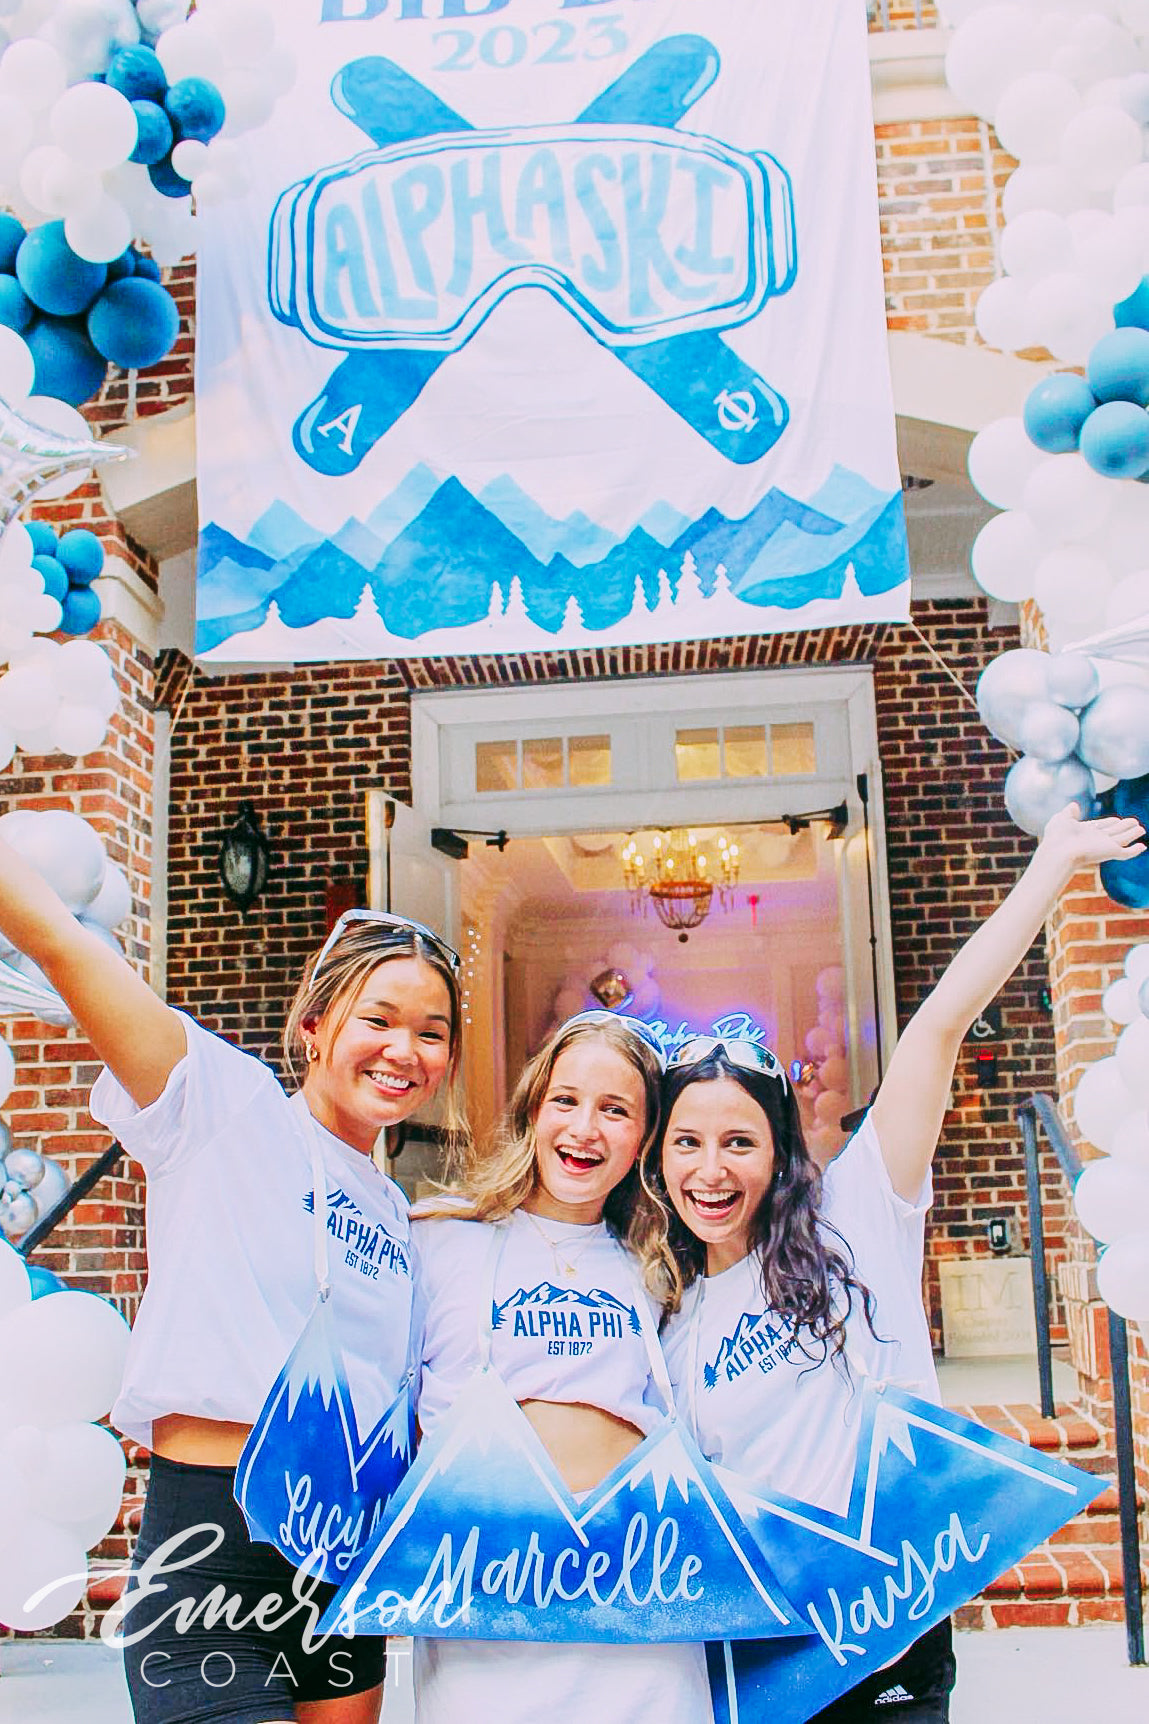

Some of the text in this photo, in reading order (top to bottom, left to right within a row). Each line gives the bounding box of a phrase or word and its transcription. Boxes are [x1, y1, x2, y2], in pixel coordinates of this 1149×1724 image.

[431, 13, 629, 71] 2023
[326, 1210, 400, 1275] ALPHA PH
[344, 1249, 380, 1281] EST 1872
[513, 1310, 623, 1339] ALPHA PHI
[547, 1340, 593, 1356] EST 1872
[725, 1323, 783, 1383] ALPHA
[758, 1353, 777, 1374] EST
[279, 1470, 365, 1572] Lucy
[415, 1511, 704, 1625] Marcelle
[874, 1694, 914, 1705] adidas
